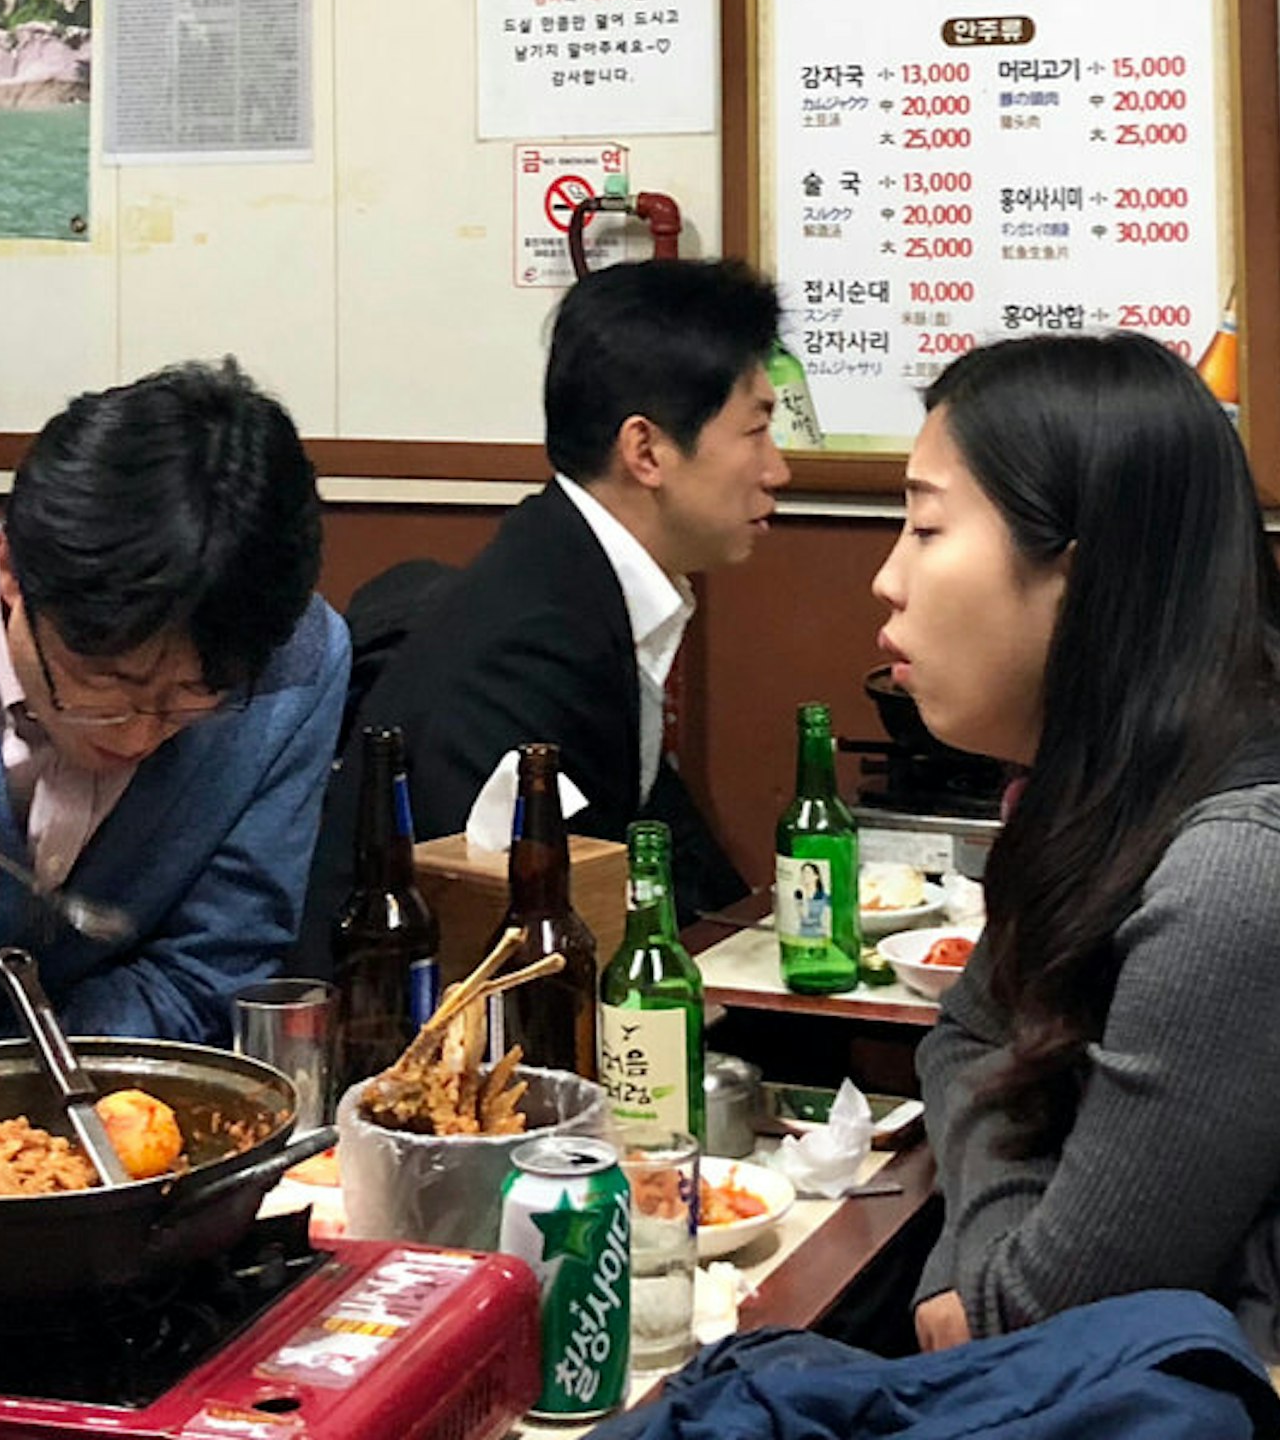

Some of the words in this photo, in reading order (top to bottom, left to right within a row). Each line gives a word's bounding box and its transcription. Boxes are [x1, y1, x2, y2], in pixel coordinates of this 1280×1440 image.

[504, 18, 532, 34] 드실
[541, 15, 586, 33] 만큼만
[595, 13, 624, 30] 덜어
[634, 9, 679, 25] 드시고
[953, 19, 1024, 44] 안주류
[515, 43, 559, 62] 남기지
[801, 64, 865, 90] 감자국
[902, 62, 970, 86] 13,000
[998, 58, 1080, 83] 머리고기
[1112, 56, 1186, 80] 15,000
[902, 96, 970, 118] 20,000
[1113, 90, 1186, 112] 20,000
[903, 128, 971, 151] 25,000
[1114, 124, 1187, 146] 25,000
[523, 150, 543, 173] 금
[601, 150, 622, 173] 연
[903, 172, 972, 194] 13,000
[999, 187, 1082, 213] 홍어사시미
[1115, 188, 1188, 211] 20,000
[903, 205, 972, 227] 20,000
[1116, 222, 1189, 245] 30,000
[904, 237, 973, 260] 25,000
[804, 280, 890, 304] 접시순대
[909, 281, 974, 304] 10,000
[1001, 304, 1084, 329] 홍어삼합
[1119, 304, 1191, 328] 25,000
[803, 331, 890, 355] 감자사리
[918, 333, 974, 355] 2,000
[554, 1188, 632, 1403] 칠성사이다
